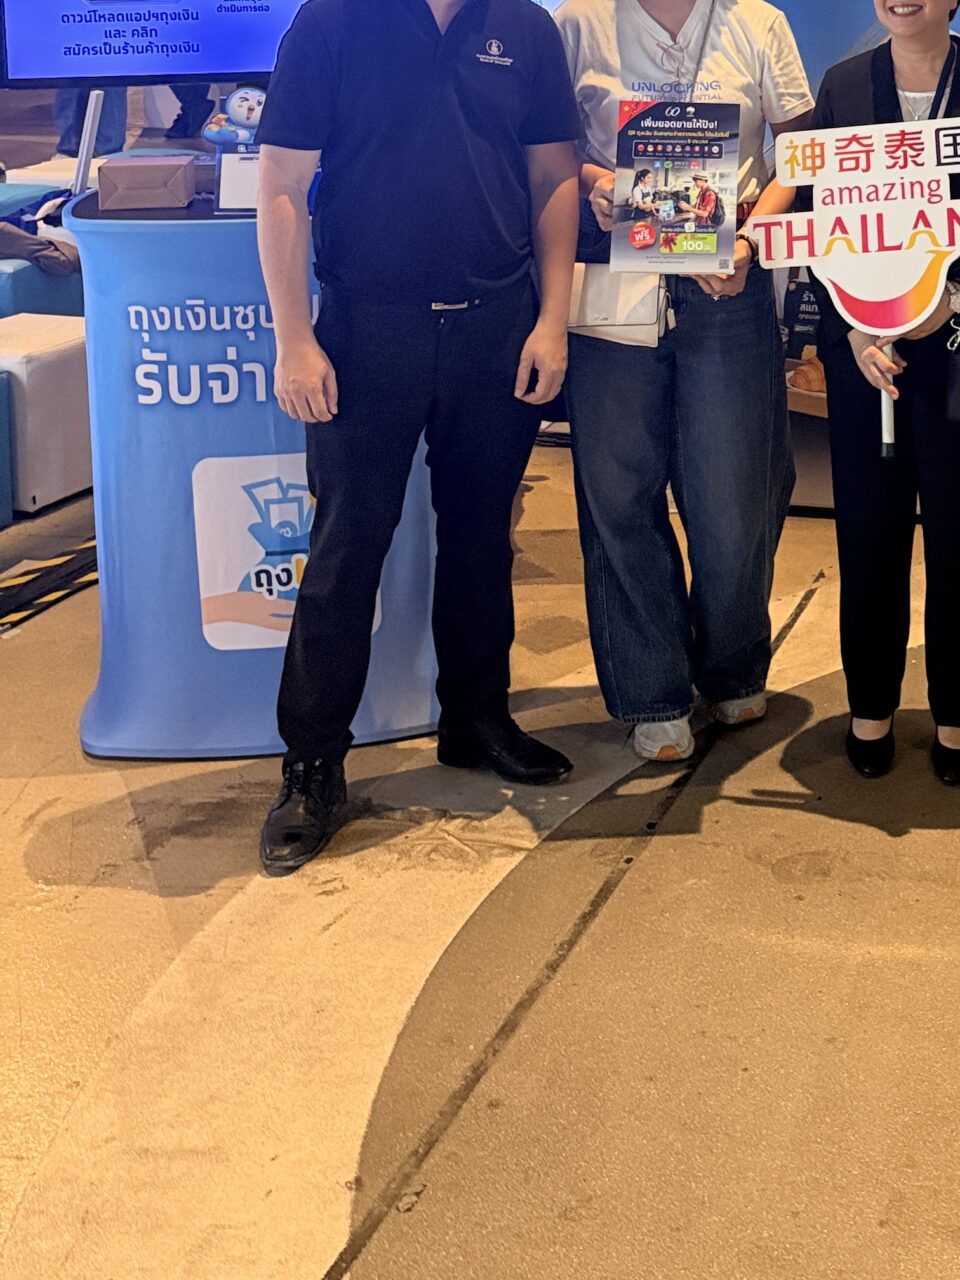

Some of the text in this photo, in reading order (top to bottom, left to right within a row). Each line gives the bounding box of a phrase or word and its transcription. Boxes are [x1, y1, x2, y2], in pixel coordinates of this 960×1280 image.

[104, 28, 126, 38] และ
[63, 41, 200, 58] สมัครเป็นร้านค้าถุงเงิน
[821, 176, 943, 206] amazing
[682, 241, 703, 250] 100
